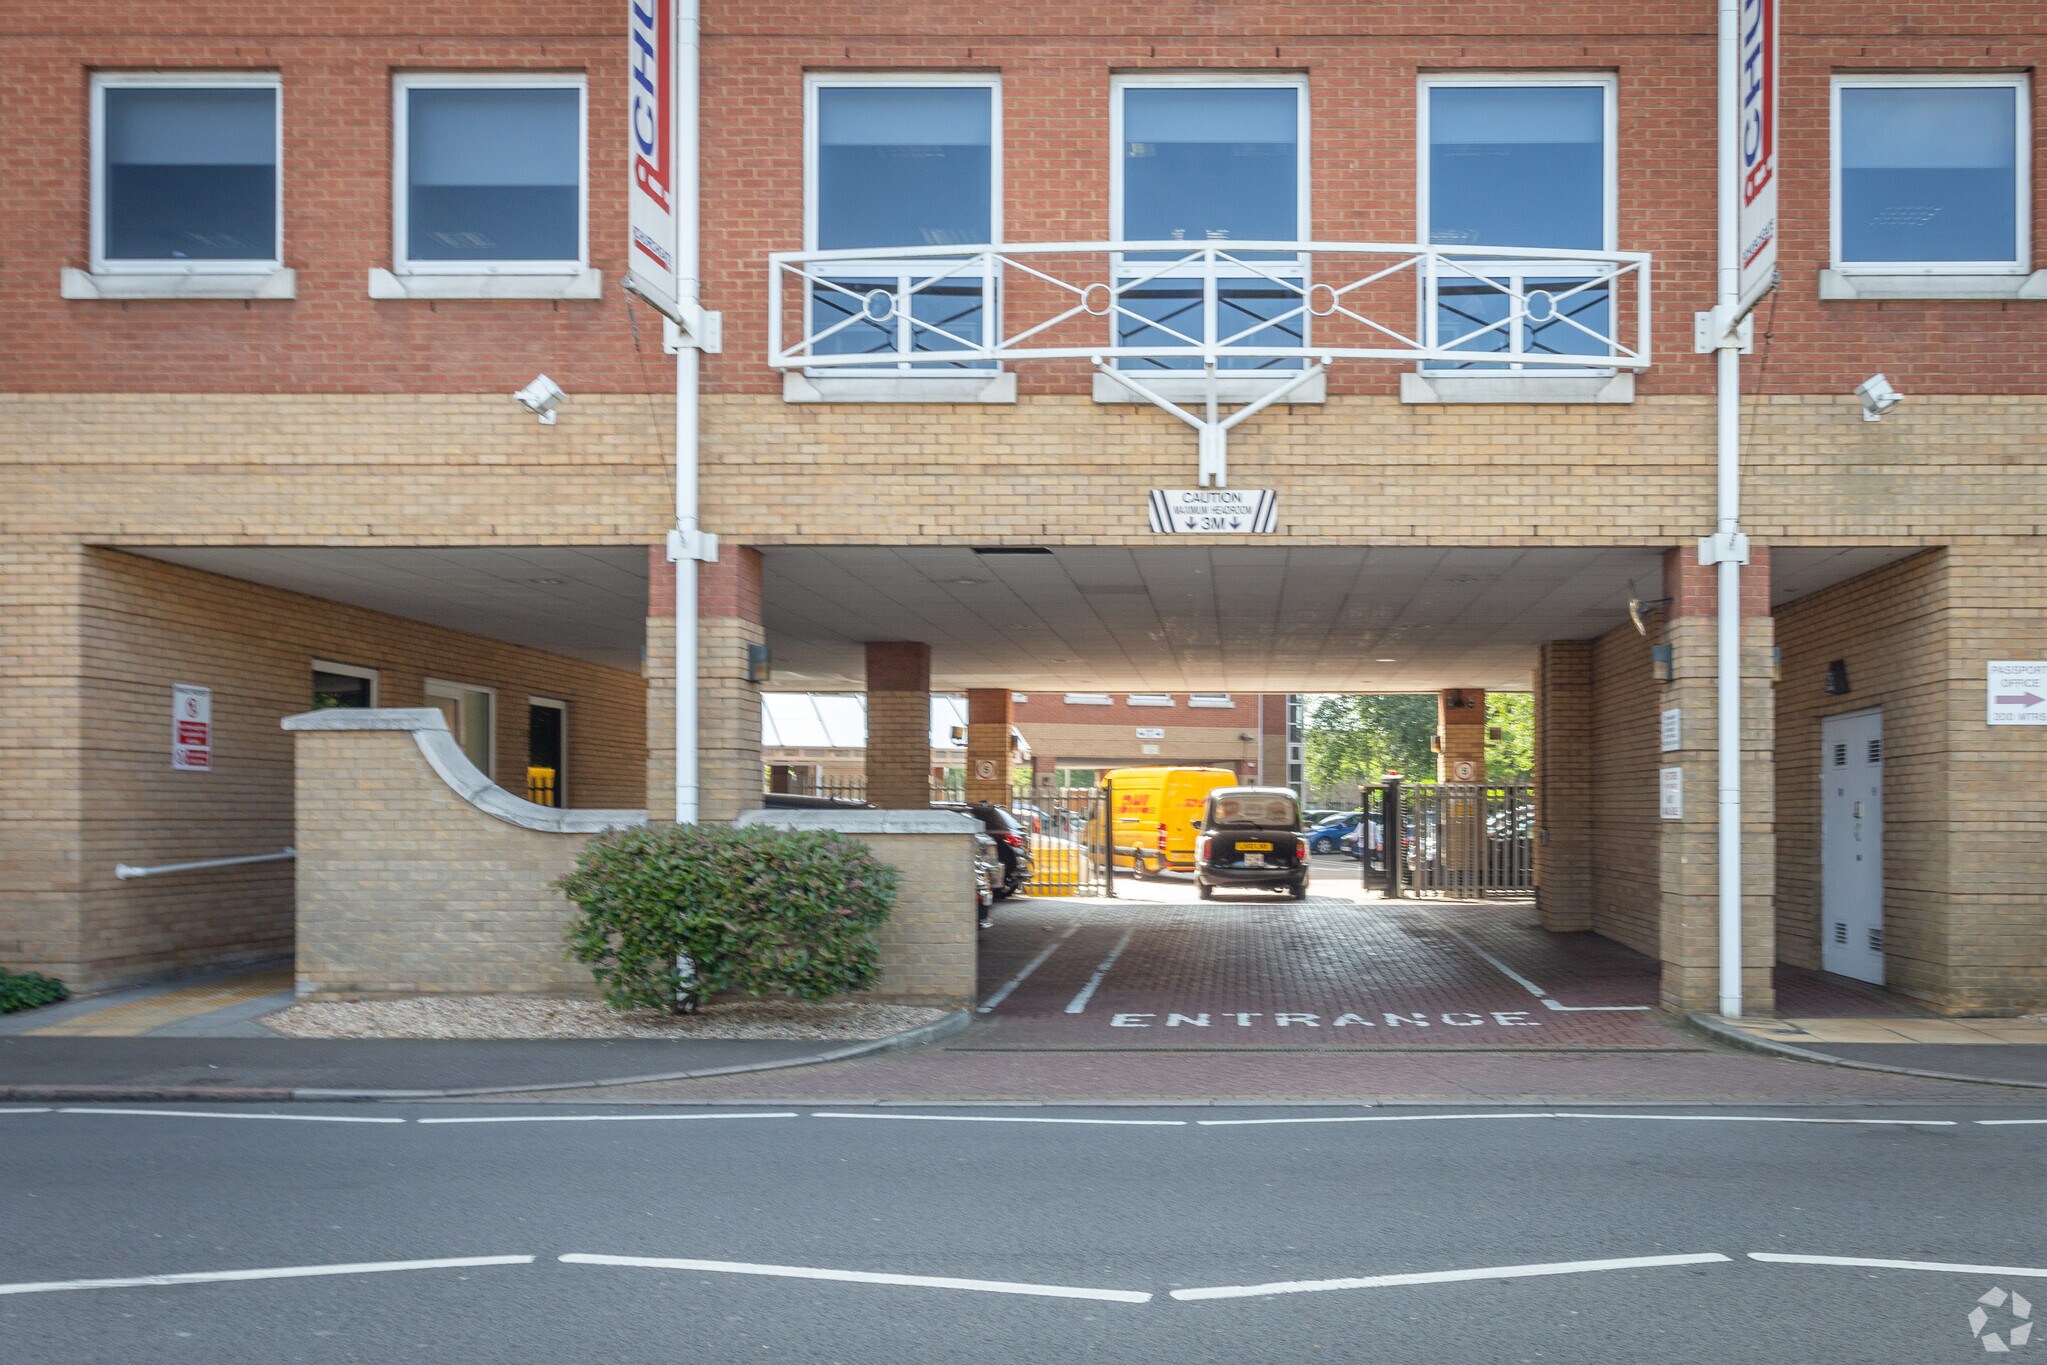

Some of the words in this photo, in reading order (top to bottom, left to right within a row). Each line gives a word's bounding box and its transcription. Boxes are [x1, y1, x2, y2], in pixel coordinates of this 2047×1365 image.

[1181, 492, 1242, 504] CAUTION
[1172, 505, 1208, 515] MAXIMUM
[1210, 505, 1253, 515] HEADROOM
[1200, 517, 1226, 530] 3M
[1991, 665, 2047, 675] PASSPORT
[2000, 678, 2041, 688] OFFICE
[1110, 1011, 1542, 1028] ENTRANCE
